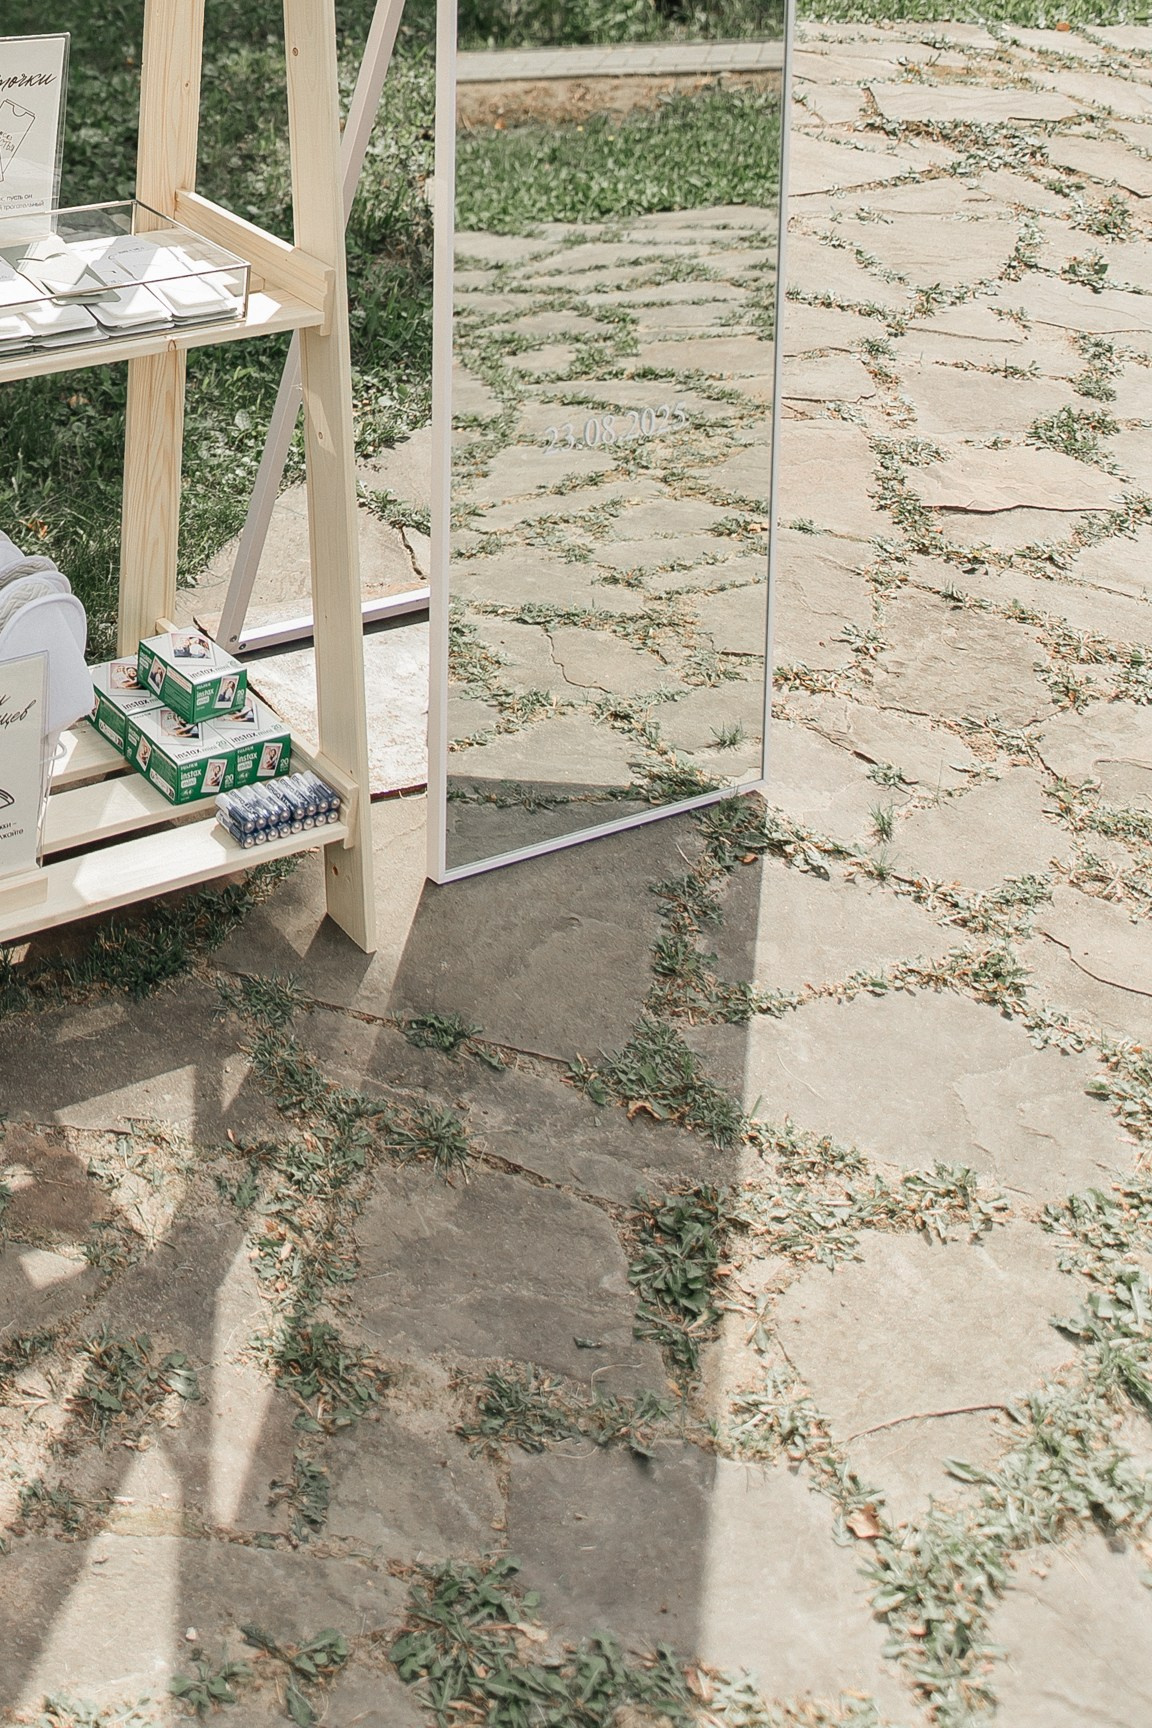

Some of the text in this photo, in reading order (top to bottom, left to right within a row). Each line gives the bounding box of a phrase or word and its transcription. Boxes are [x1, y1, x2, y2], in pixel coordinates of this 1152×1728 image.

[542, 402, 690, 455] 23.08.2025
[122, 699, 149, 710] instax
[230, 732, 257, 743] instax
[175, 749, 201, 760] instax
[237, 752, 257, 763] instax
[181, 769, 201, 780] instax
